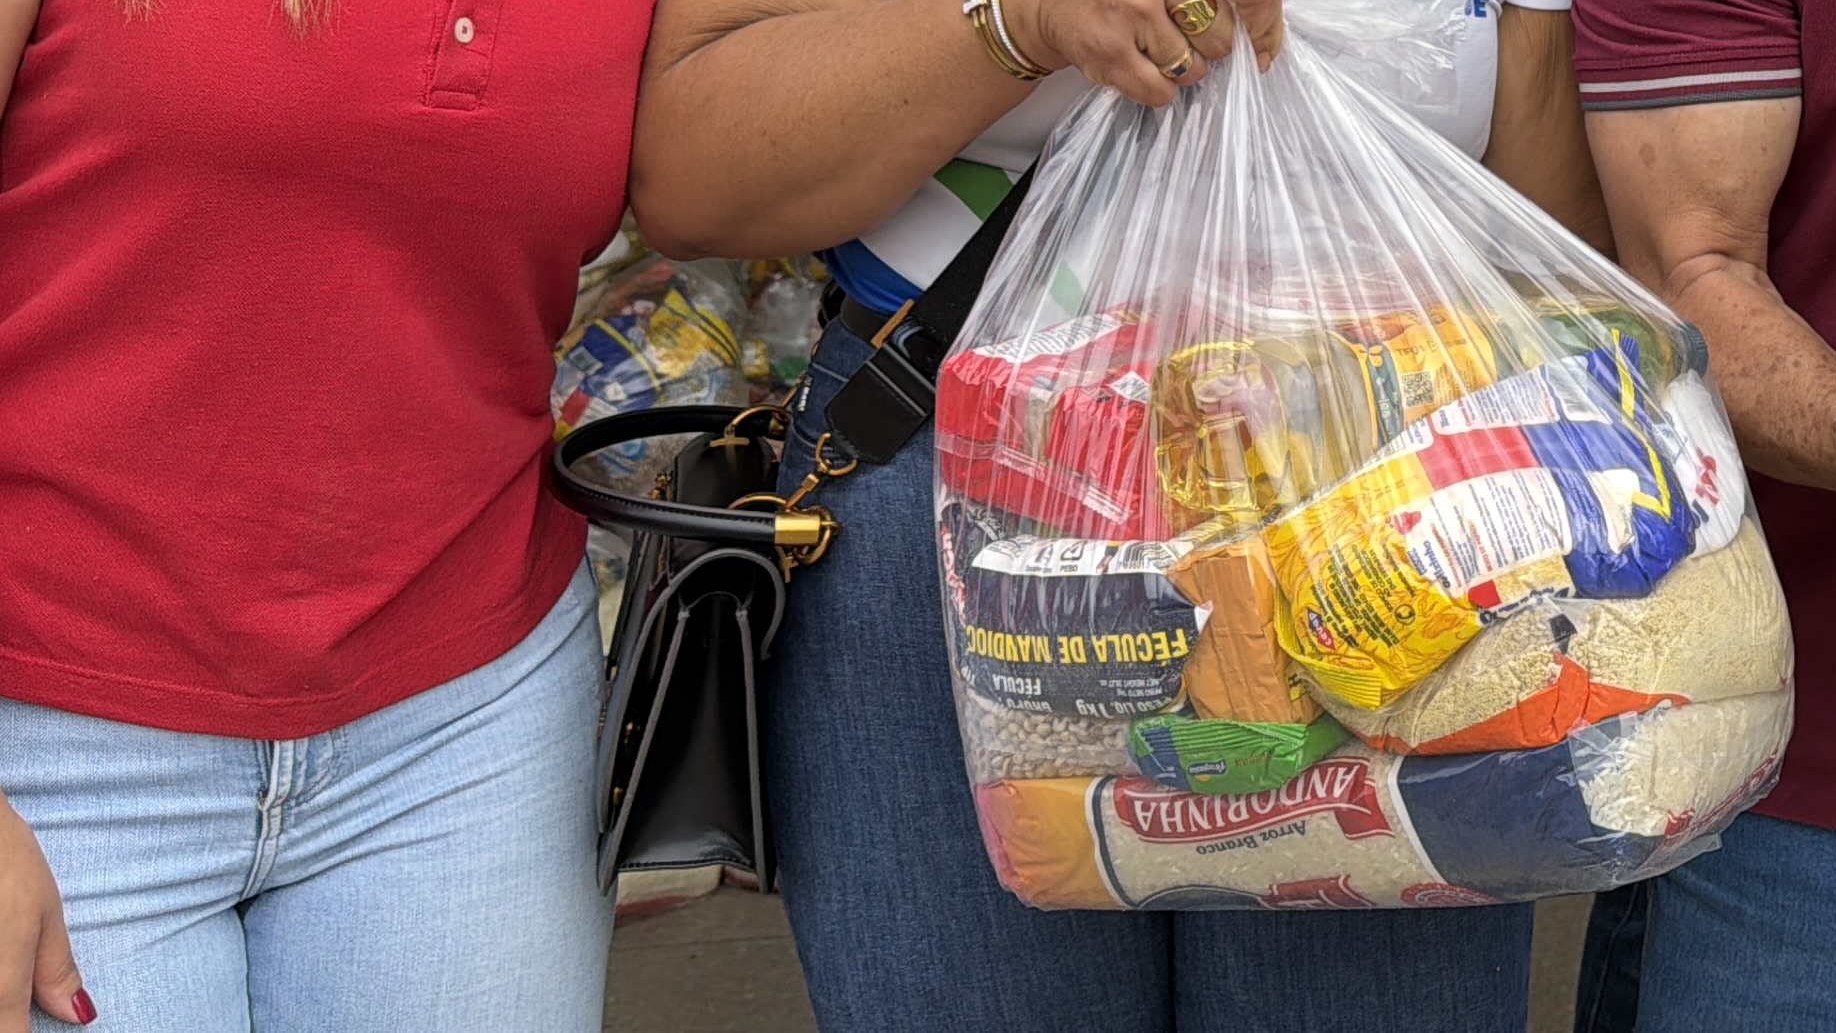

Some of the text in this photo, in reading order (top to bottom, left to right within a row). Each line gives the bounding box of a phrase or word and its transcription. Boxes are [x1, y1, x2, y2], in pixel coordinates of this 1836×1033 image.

[965, 624, 1190, 667] FÉCULA DE MANDIOC
[992, 673, 1042, 699] FÉCULA
[1133, 764, 1361, 833] ANDORINHA
[1195, 820, 1307, 856] Arroz Branco
